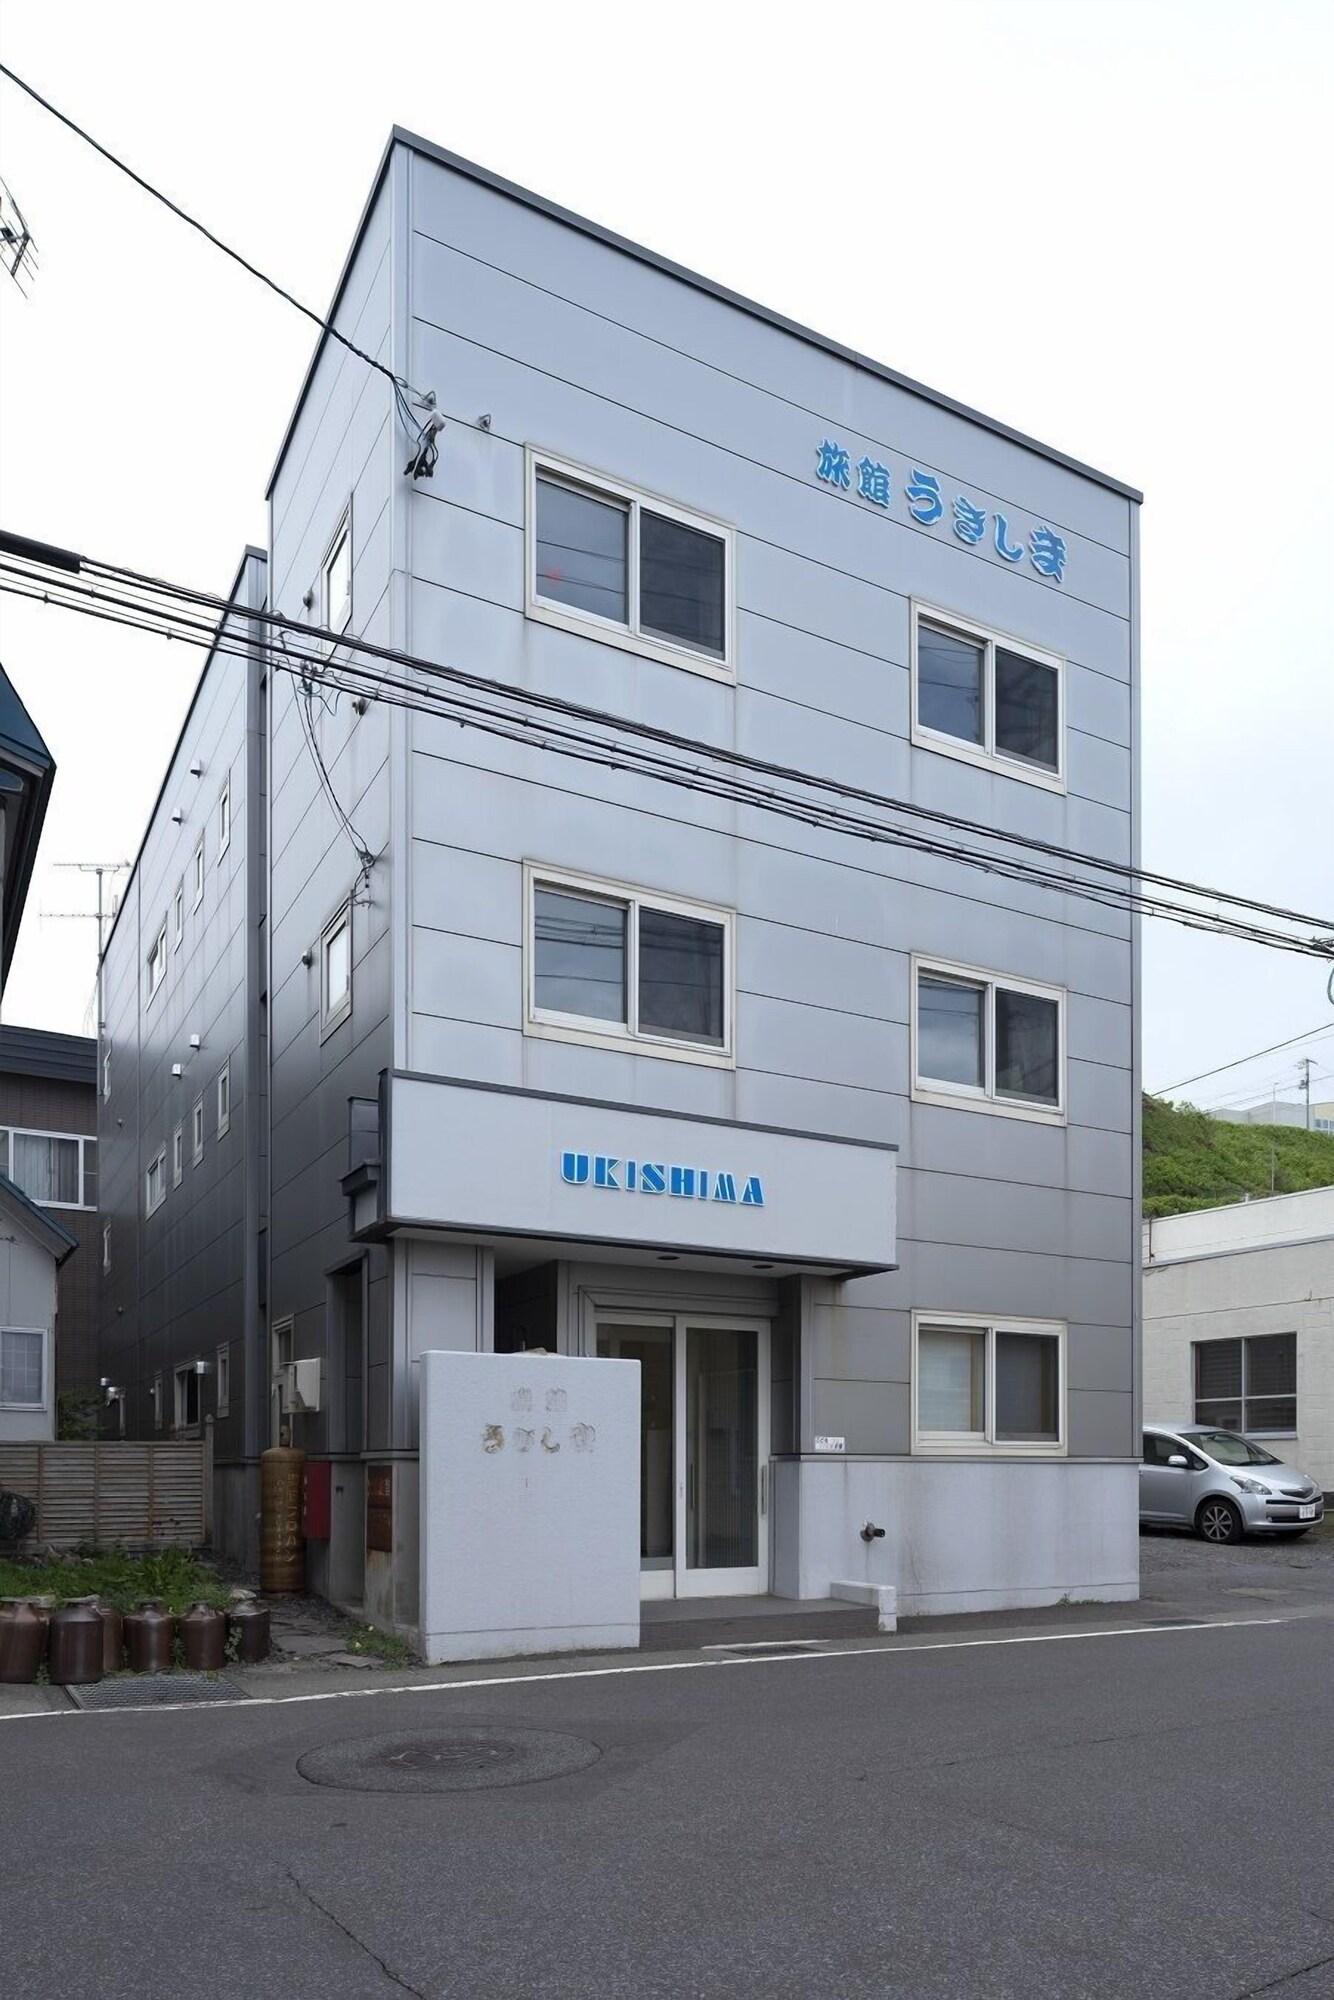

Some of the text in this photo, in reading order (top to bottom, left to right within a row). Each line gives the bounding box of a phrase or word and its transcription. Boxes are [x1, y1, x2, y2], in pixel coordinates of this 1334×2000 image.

[816, 439, 1068, 583] 旅館 うきしま
[560, 1151, 766, 1207] UKISHIMA
